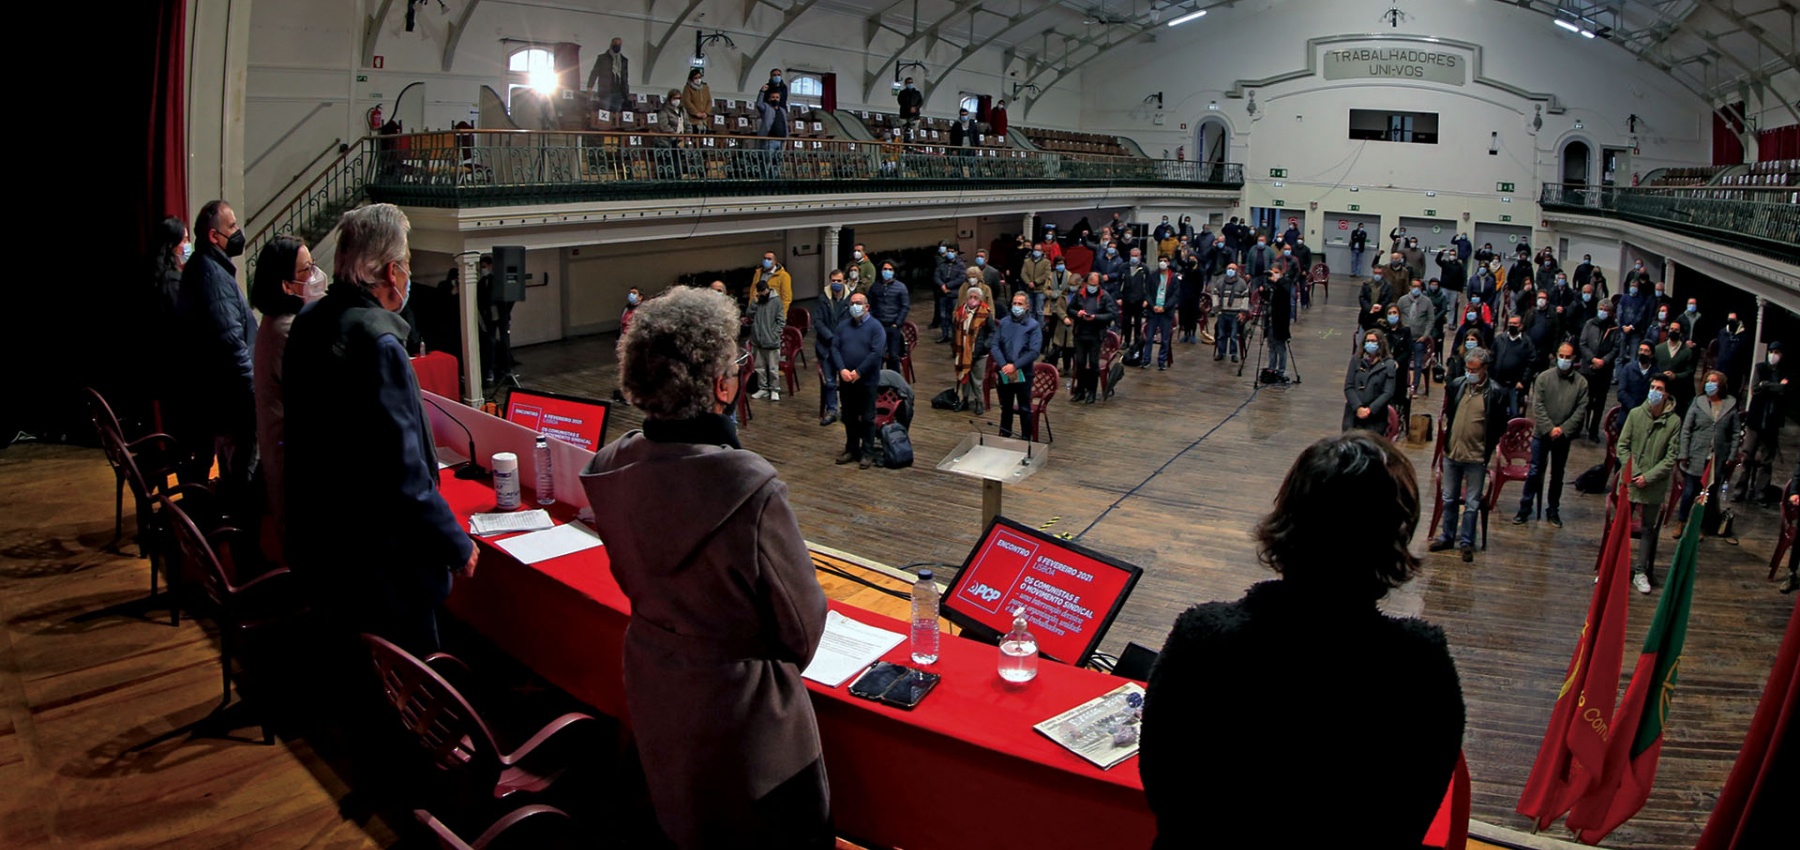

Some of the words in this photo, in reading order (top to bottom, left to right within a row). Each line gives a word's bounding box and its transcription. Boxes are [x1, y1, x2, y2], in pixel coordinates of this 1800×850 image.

[1333, 50, 1456, 67] TRABALHADORES
[1369, 64, 1424, 77] UNI-VOS
[997, 540, 1030, 556] ENCONTRO
[1032, 562, 1056, 576] LISBOA
[1037, 555, 1045, 563] 6
[1041, 557, 1078, 576] FEVEREIRO
[1076, 571, 1094, 583] 2021
[977, 584, 1001, 602] PCP
[1024, 576, 1035, 585] OS
[1033, 580, 1075, 602] COMUNISTAS
[1073, 596, 1081, 604] E
[1020, 583, 1027, 591] O
[1025, 585, 1064, 606] MOVIMENTO
[1062, 601, 1094, 619] SINDICAL
